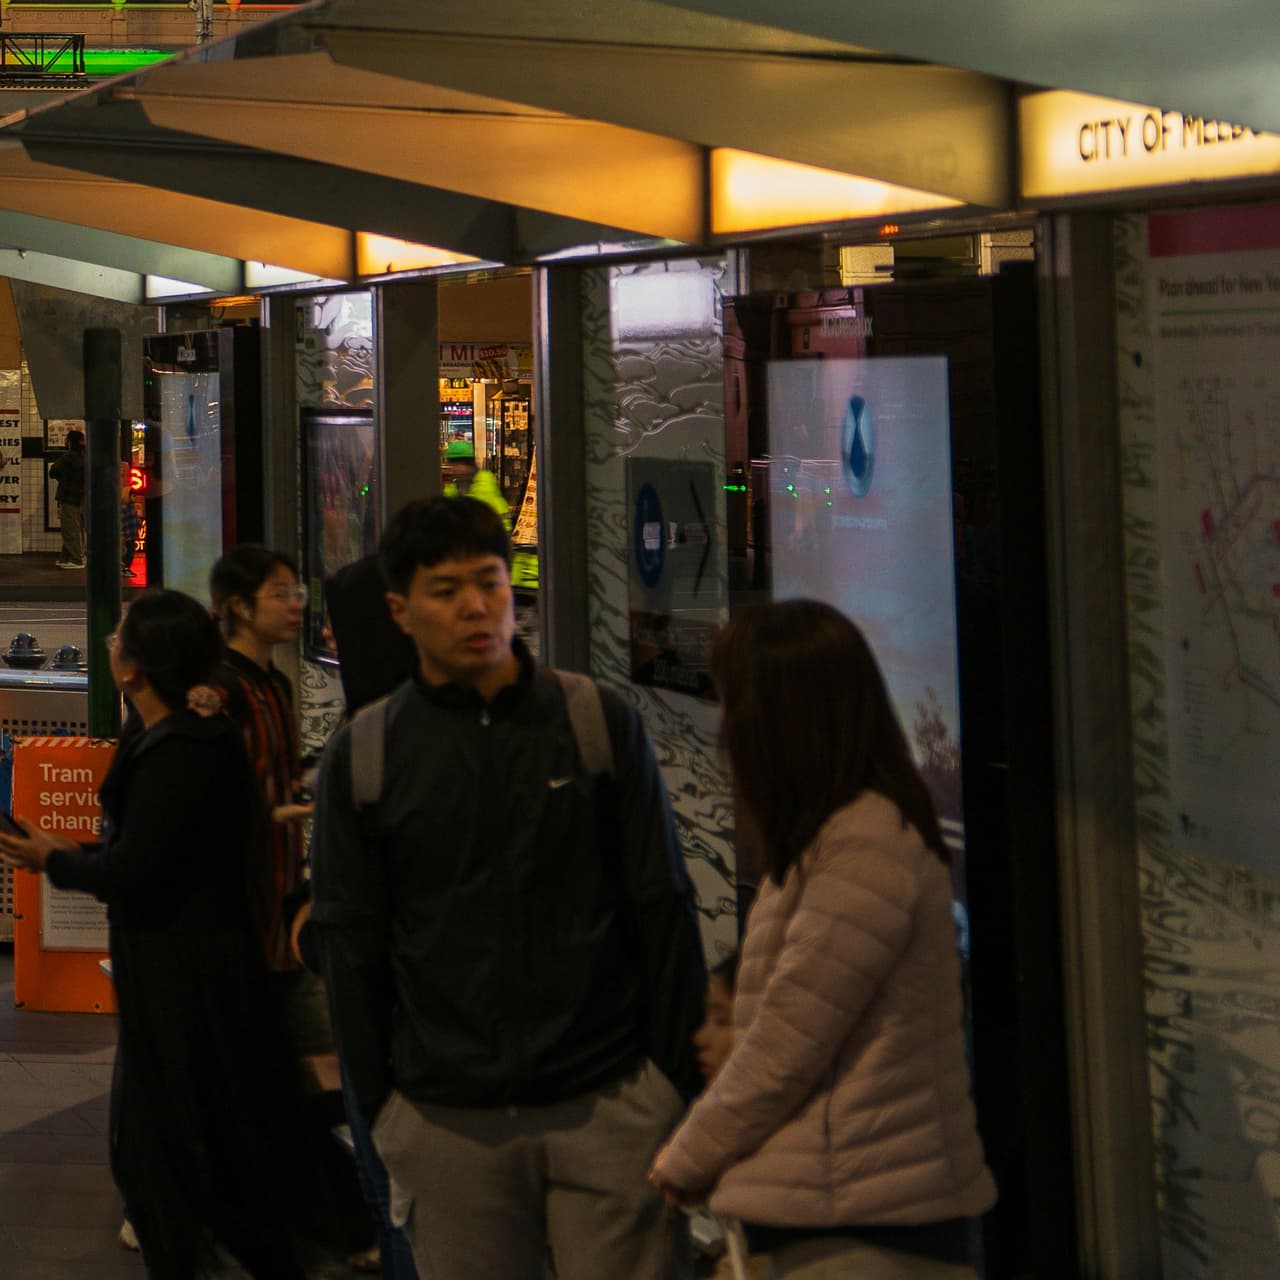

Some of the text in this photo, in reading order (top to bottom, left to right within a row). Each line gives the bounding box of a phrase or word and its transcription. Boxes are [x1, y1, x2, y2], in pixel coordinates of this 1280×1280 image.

[1079, 118, 1131, 161] CITY
[1142, 111, 1183, 153] OF
[0, 495, 19, 503] RY
[39, 763, 93, 783] Tram
[40, 787, 102, 806] servic
[40, 810, 102, 835] chang
